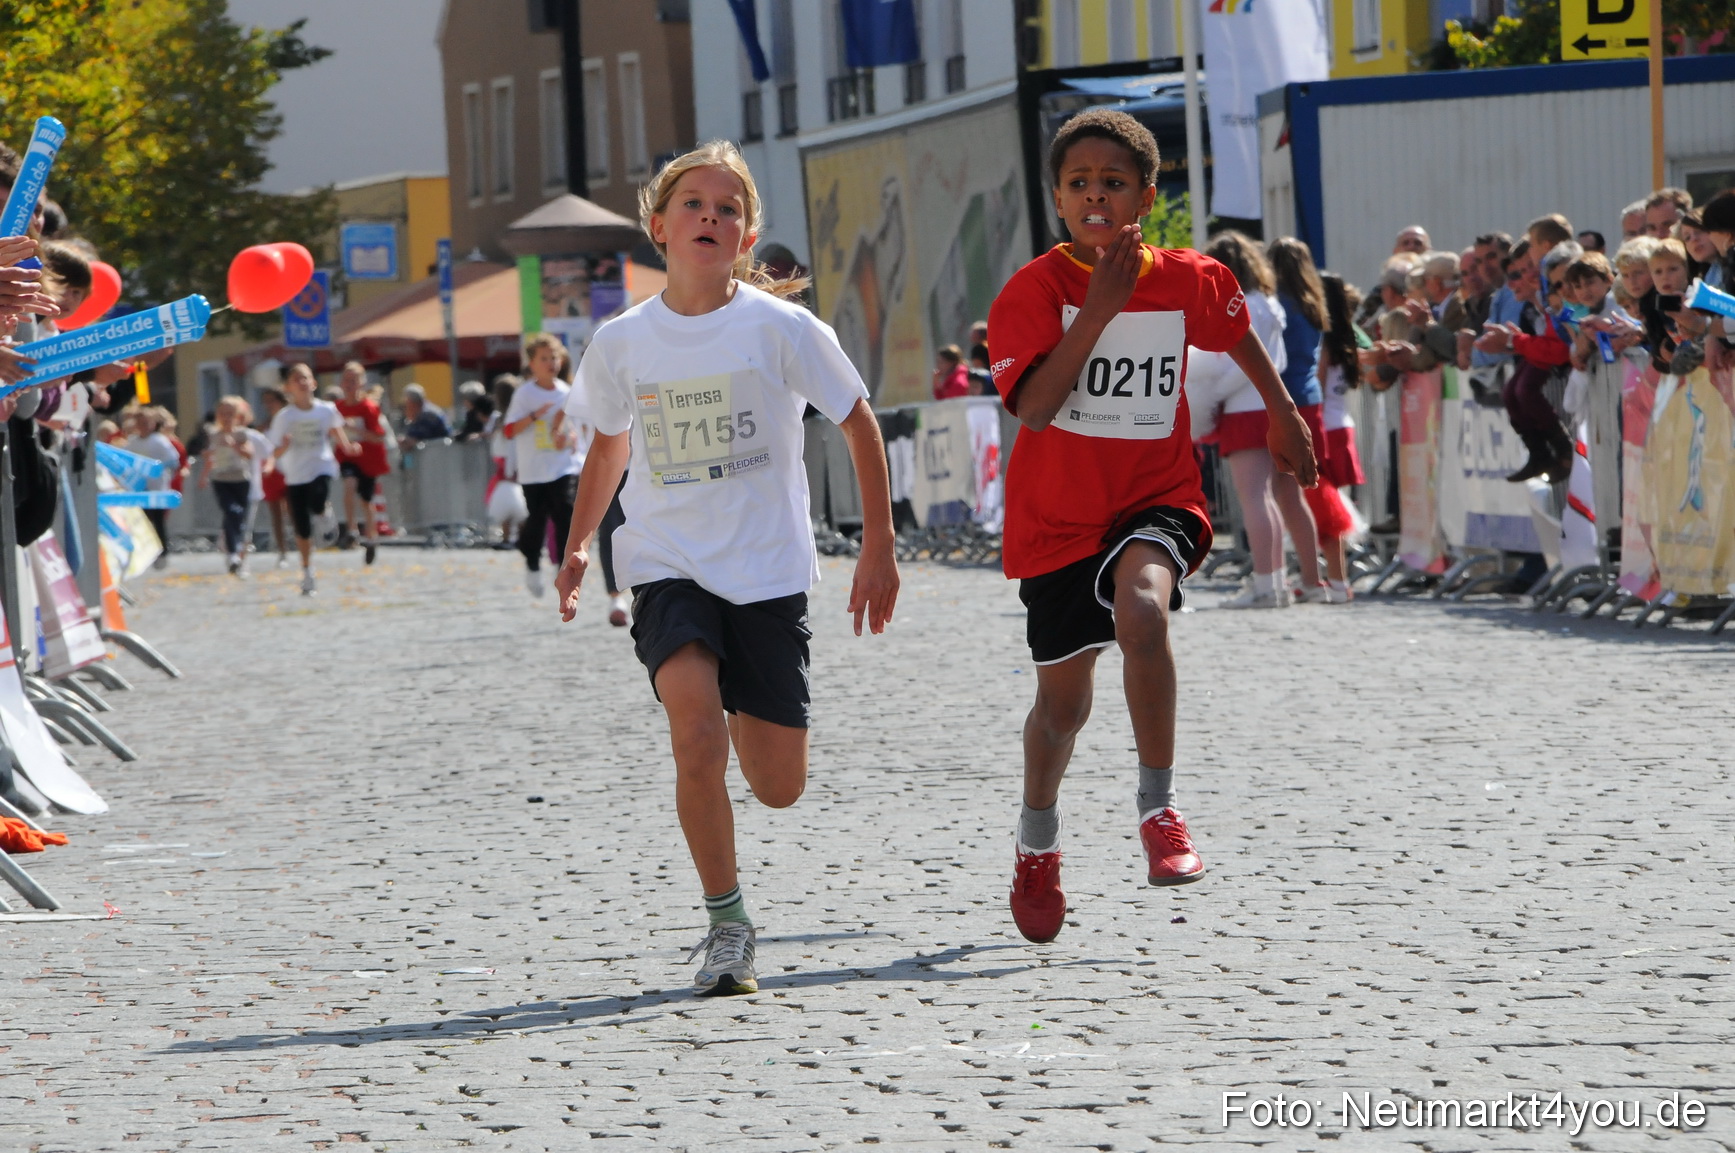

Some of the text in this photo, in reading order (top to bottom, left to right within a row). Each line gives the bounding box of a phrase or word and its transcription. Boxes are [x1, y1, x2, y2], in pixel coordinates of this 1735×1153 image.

[25, 314, 154, 360] ww.maxi-dsl.de
[1073, 356, 1176, 397] 0215
[665, 389, 723, 409] Teresa
[673, 410, 757, 450] 7155
[1081, 411, 1121, 422] PFLEIDERER
[723, 452, 770, 473] PFLEIDERER
